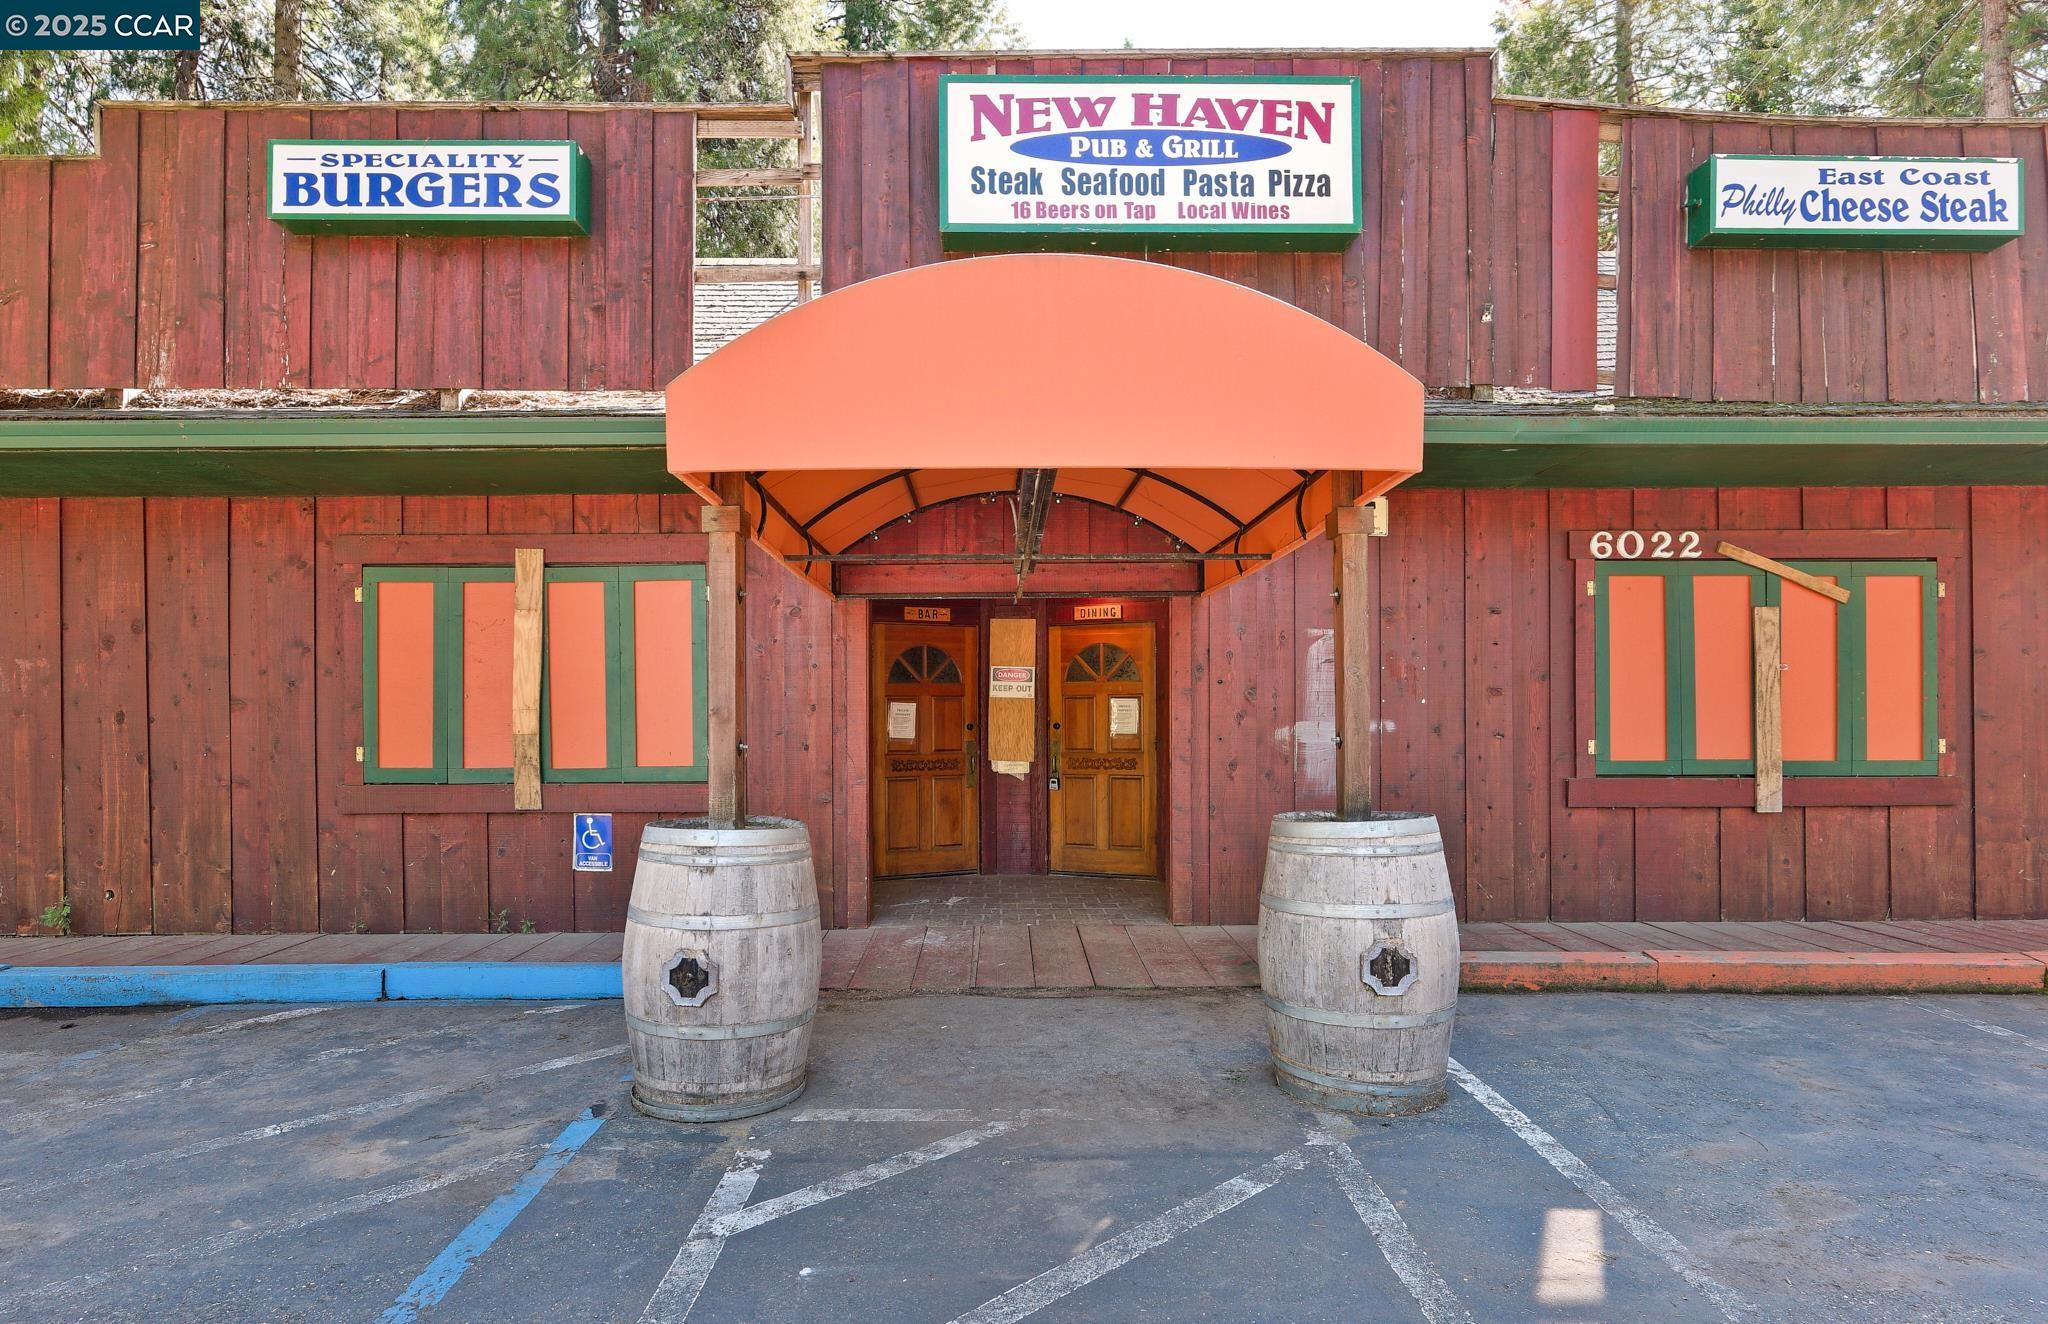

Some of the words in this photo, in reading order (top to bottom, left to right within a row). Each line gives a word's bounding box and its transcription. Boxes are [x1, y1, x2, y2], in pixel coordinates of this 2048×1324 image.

[970, 93, 1116, 142] NEW
[1131, 92, 1335, 144] HAVEN
[1070, 136, 1127, 159] PUB
[1135, 139, 1154, 158] &
[1163, 136, 1239, 159] GRILL
[320, 153, 525, 168] SPECIALITY
[970, 166, 1044, 196] Steak
[1061, 167, 1165, 197] Seafood
[1184, 168, 1255, 197] Pasta
[1269, 169, 1332, 198] Pizza
[1818, 168, 1885, 186] East
[1900, 168, 1991, 186] Coast
[283, 171, 561, 209] BURGERS
[1011, 202, 1031, 220] 16
[1036, 202, 1091, 220] Beers
[1095, 204, 1117, 220] on
[1124, 202, 1156, 221] Tap
[1178, 202, 1227, 220] Local
[1232, 202, 1290, 220] Wines
[1721, 183, 1797, 226] Philly
[1800, 188, 1910, 223] Cheese
[1920, 189, 2009, 223] Steak
[1589, 530, 1703, 559] 6022
[917, 608, 939, 620] BAR
[1080, 607, 1117, 619] DINING
[998, 671, 1027, 679] DANGER
[992, 684, 1014, 692] KEEP
[1016, 685, 1033, 693] OUT
